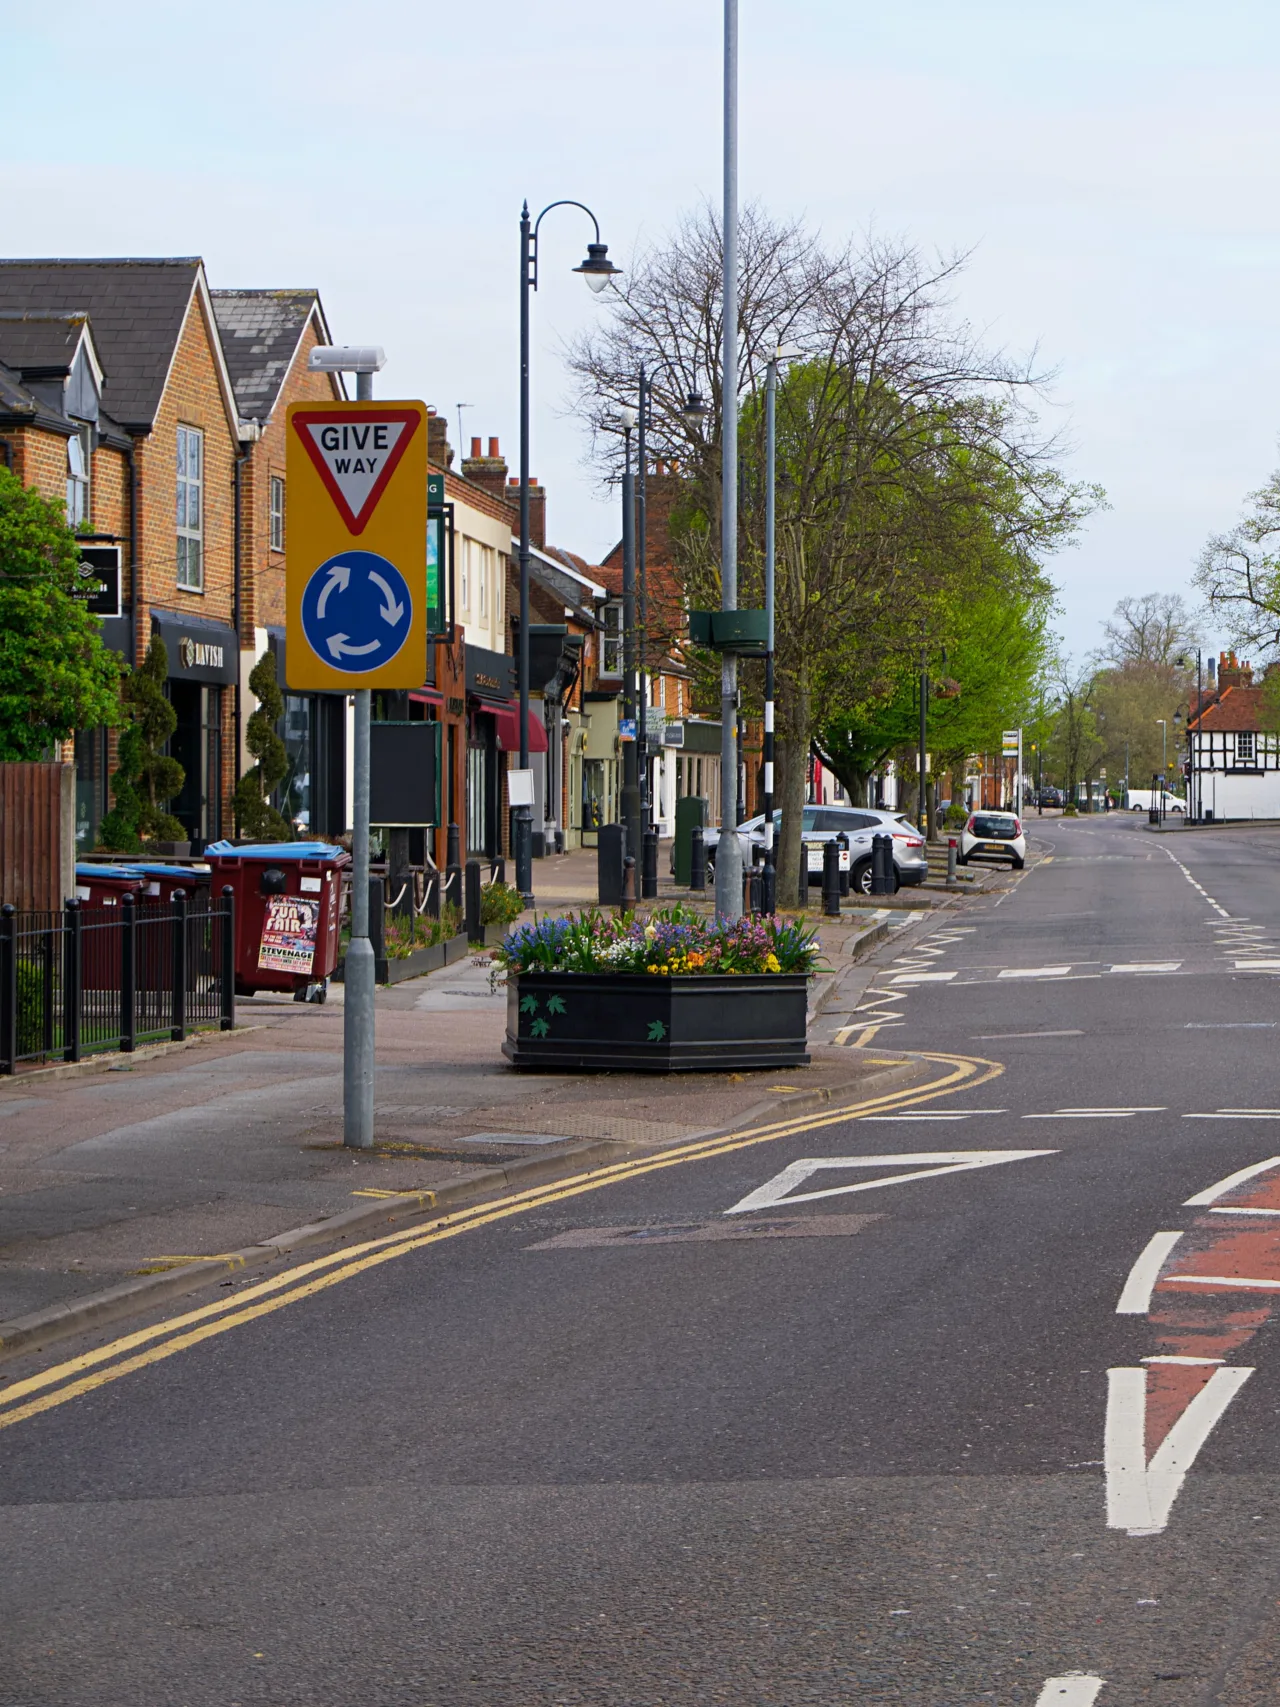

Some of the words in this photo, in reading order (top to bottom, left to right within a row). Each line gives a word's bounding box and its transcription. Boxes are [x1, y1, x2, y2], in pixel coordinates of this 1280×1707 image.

[321, 425, 388, 451] GIVE
[335, 458, 377, 474] WAY
[196, 643, 223, 668] LAVISH
[271, 906, 298, 919] FUN
[266, 917, 301, 932] FAIR
[261, 946, 313, 959] STEVENAGE
